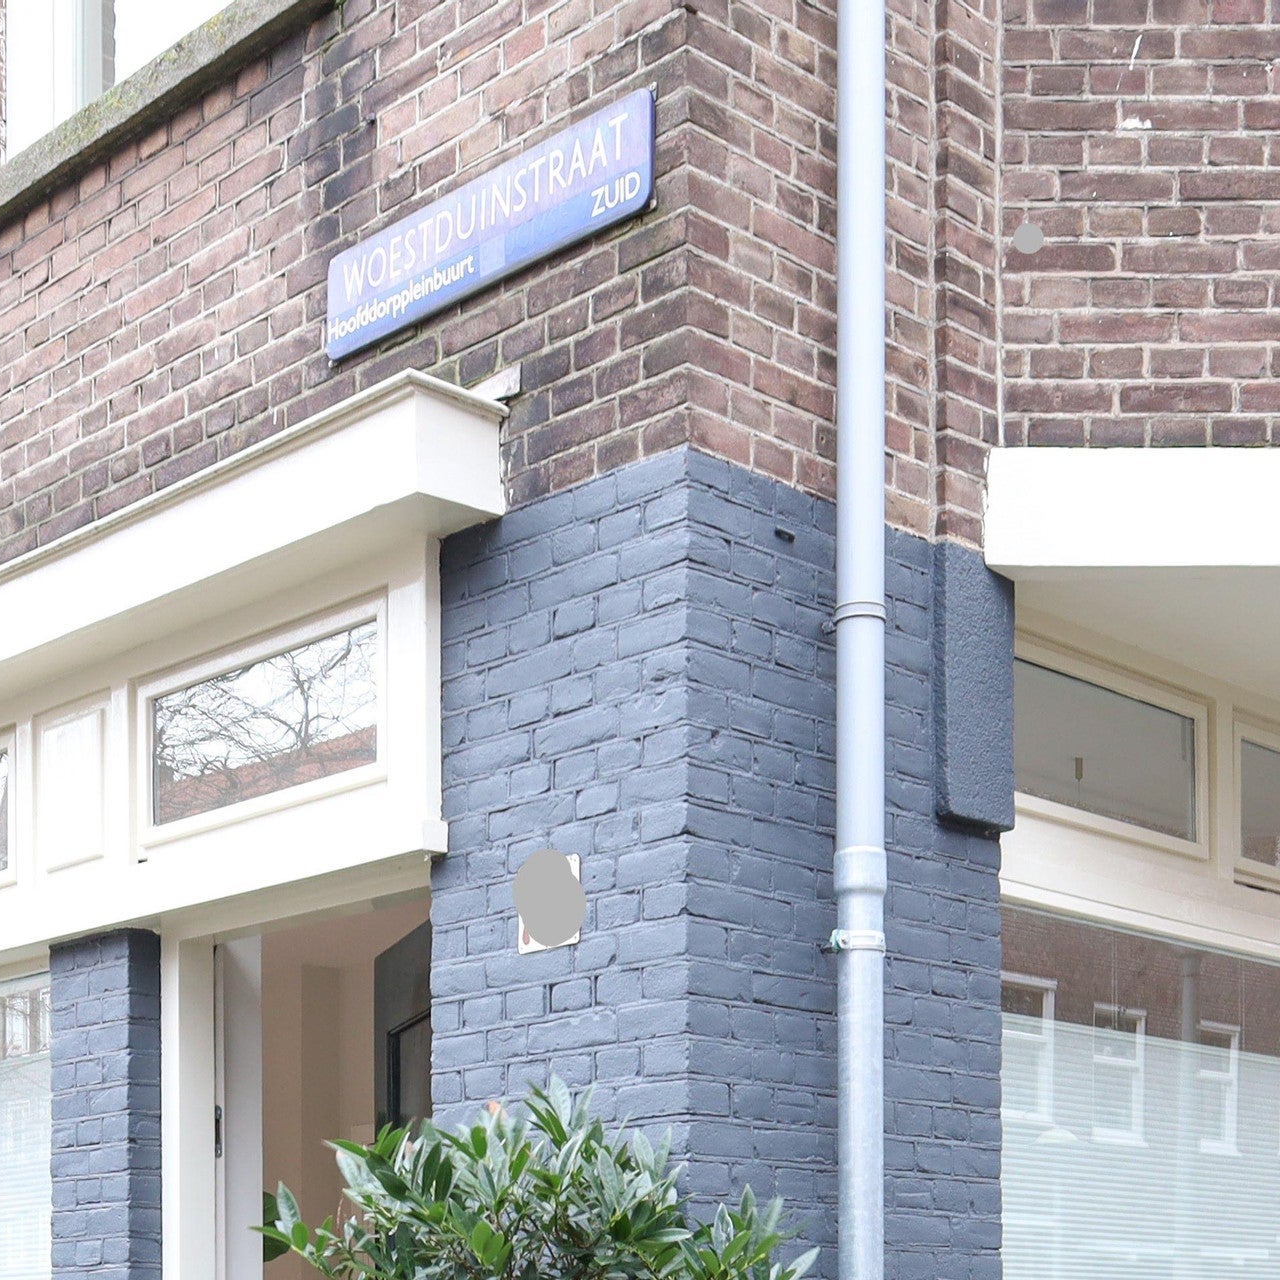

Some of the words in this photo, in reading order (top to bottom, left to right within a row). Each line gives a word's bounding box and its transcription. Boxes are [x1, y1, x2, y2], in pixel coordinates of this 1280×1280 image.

[342, 112, 629, 302] WOESTDUINSTRAAT
[590, 171, 641, 219] ZUID
[326, 255, 475, 344] Hoofddorppleinbuurt
